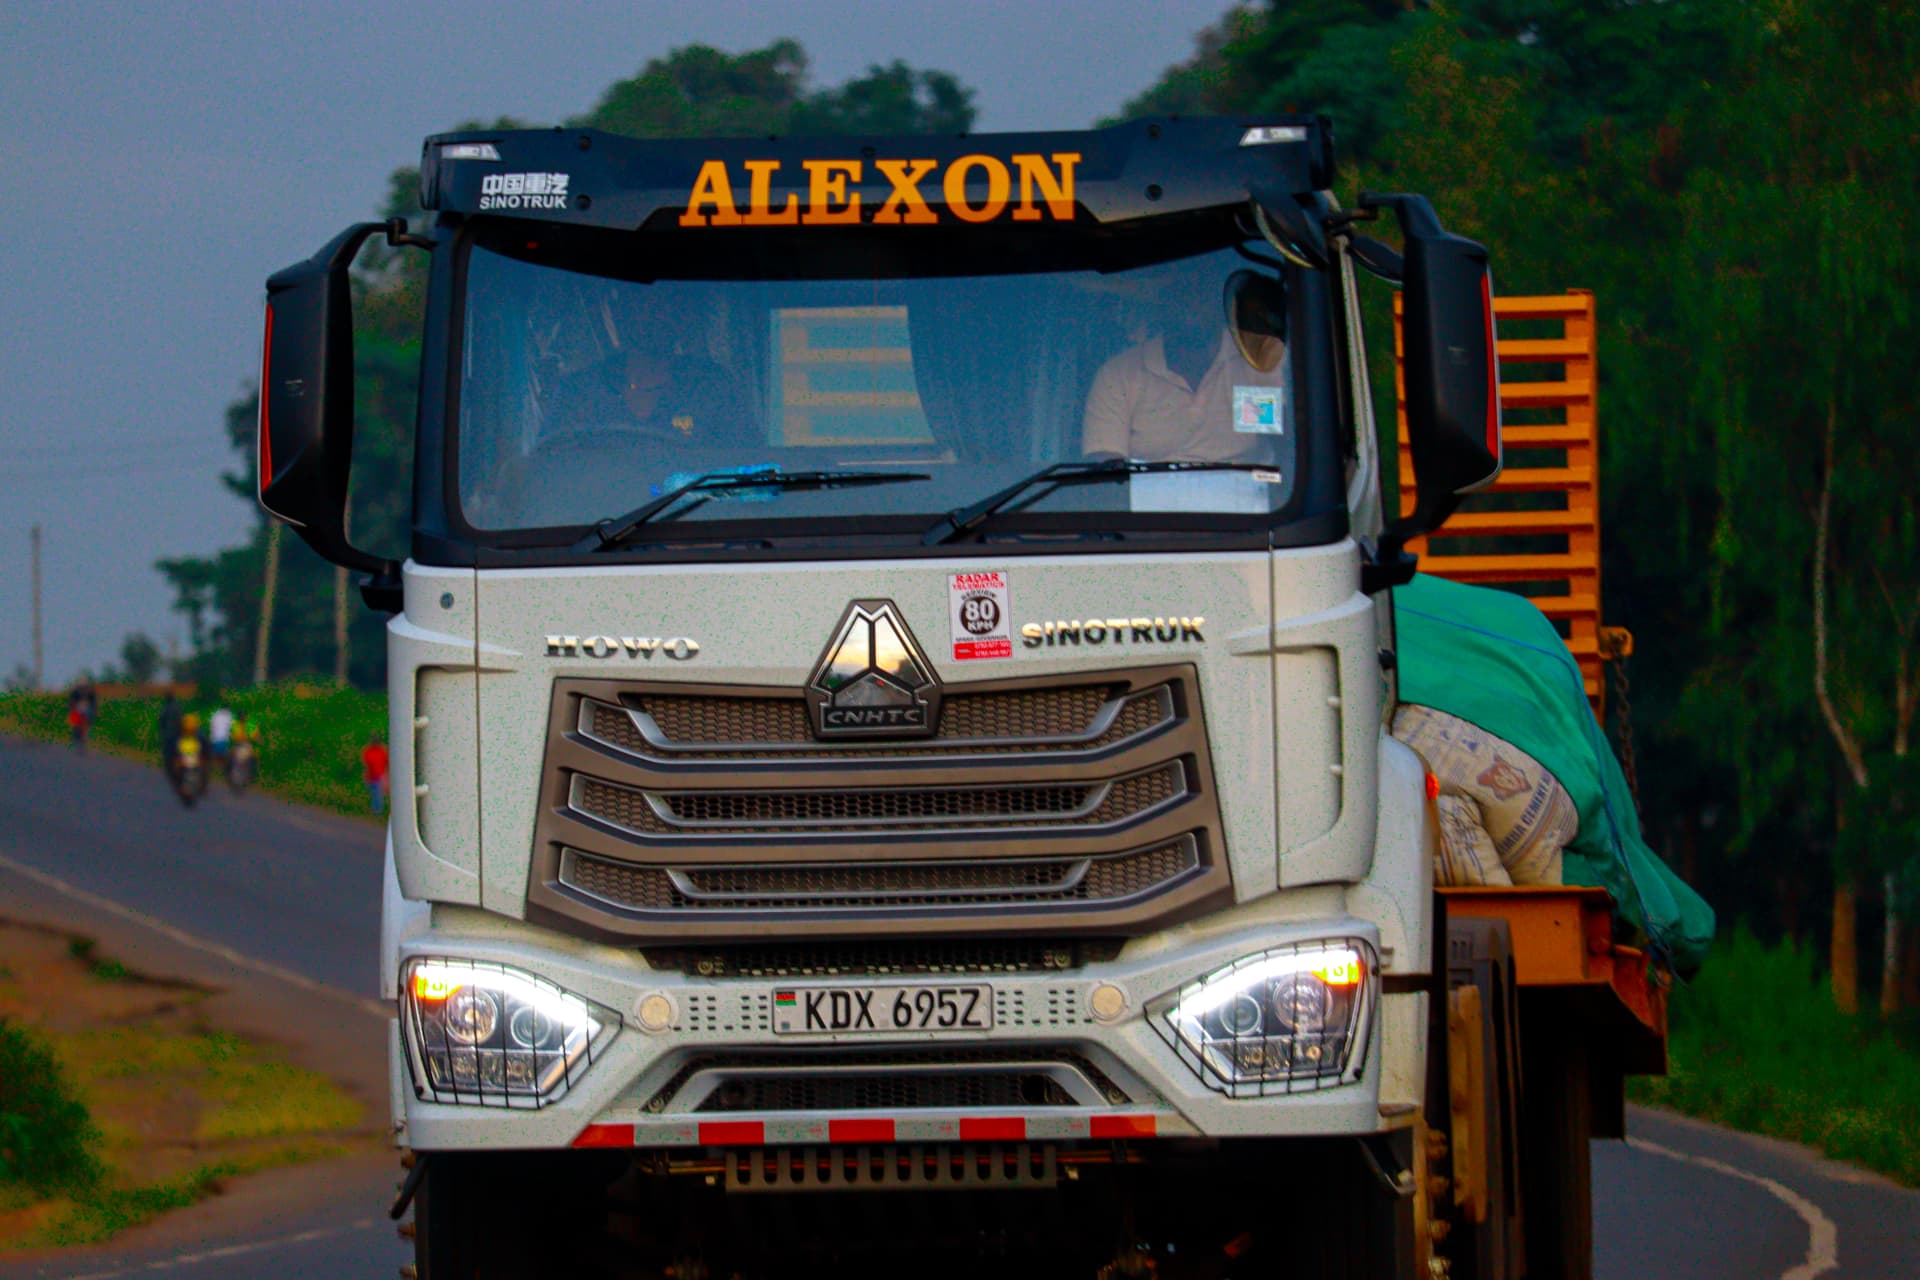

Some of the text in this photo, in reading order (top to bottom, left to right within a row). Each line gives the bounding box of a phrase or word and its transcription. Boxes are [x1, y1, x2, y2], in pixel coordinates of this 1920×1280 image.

[482, 172, 569, 195] 中国重汽
[679, 153, 1081, 227] ALEXON
[480, 195, 567, 209] SINOTRUK
[964, 600, 994, 621] 80
[1021, 616, 1206, 649] SINOTRUK
[543, 634, 700, 660] HOWO
[827, 710, 921, 724] CNHTC
[1521, 780, 1549, 827] CEMENT
[806, 988, 982, 1030] KDX 695Z
